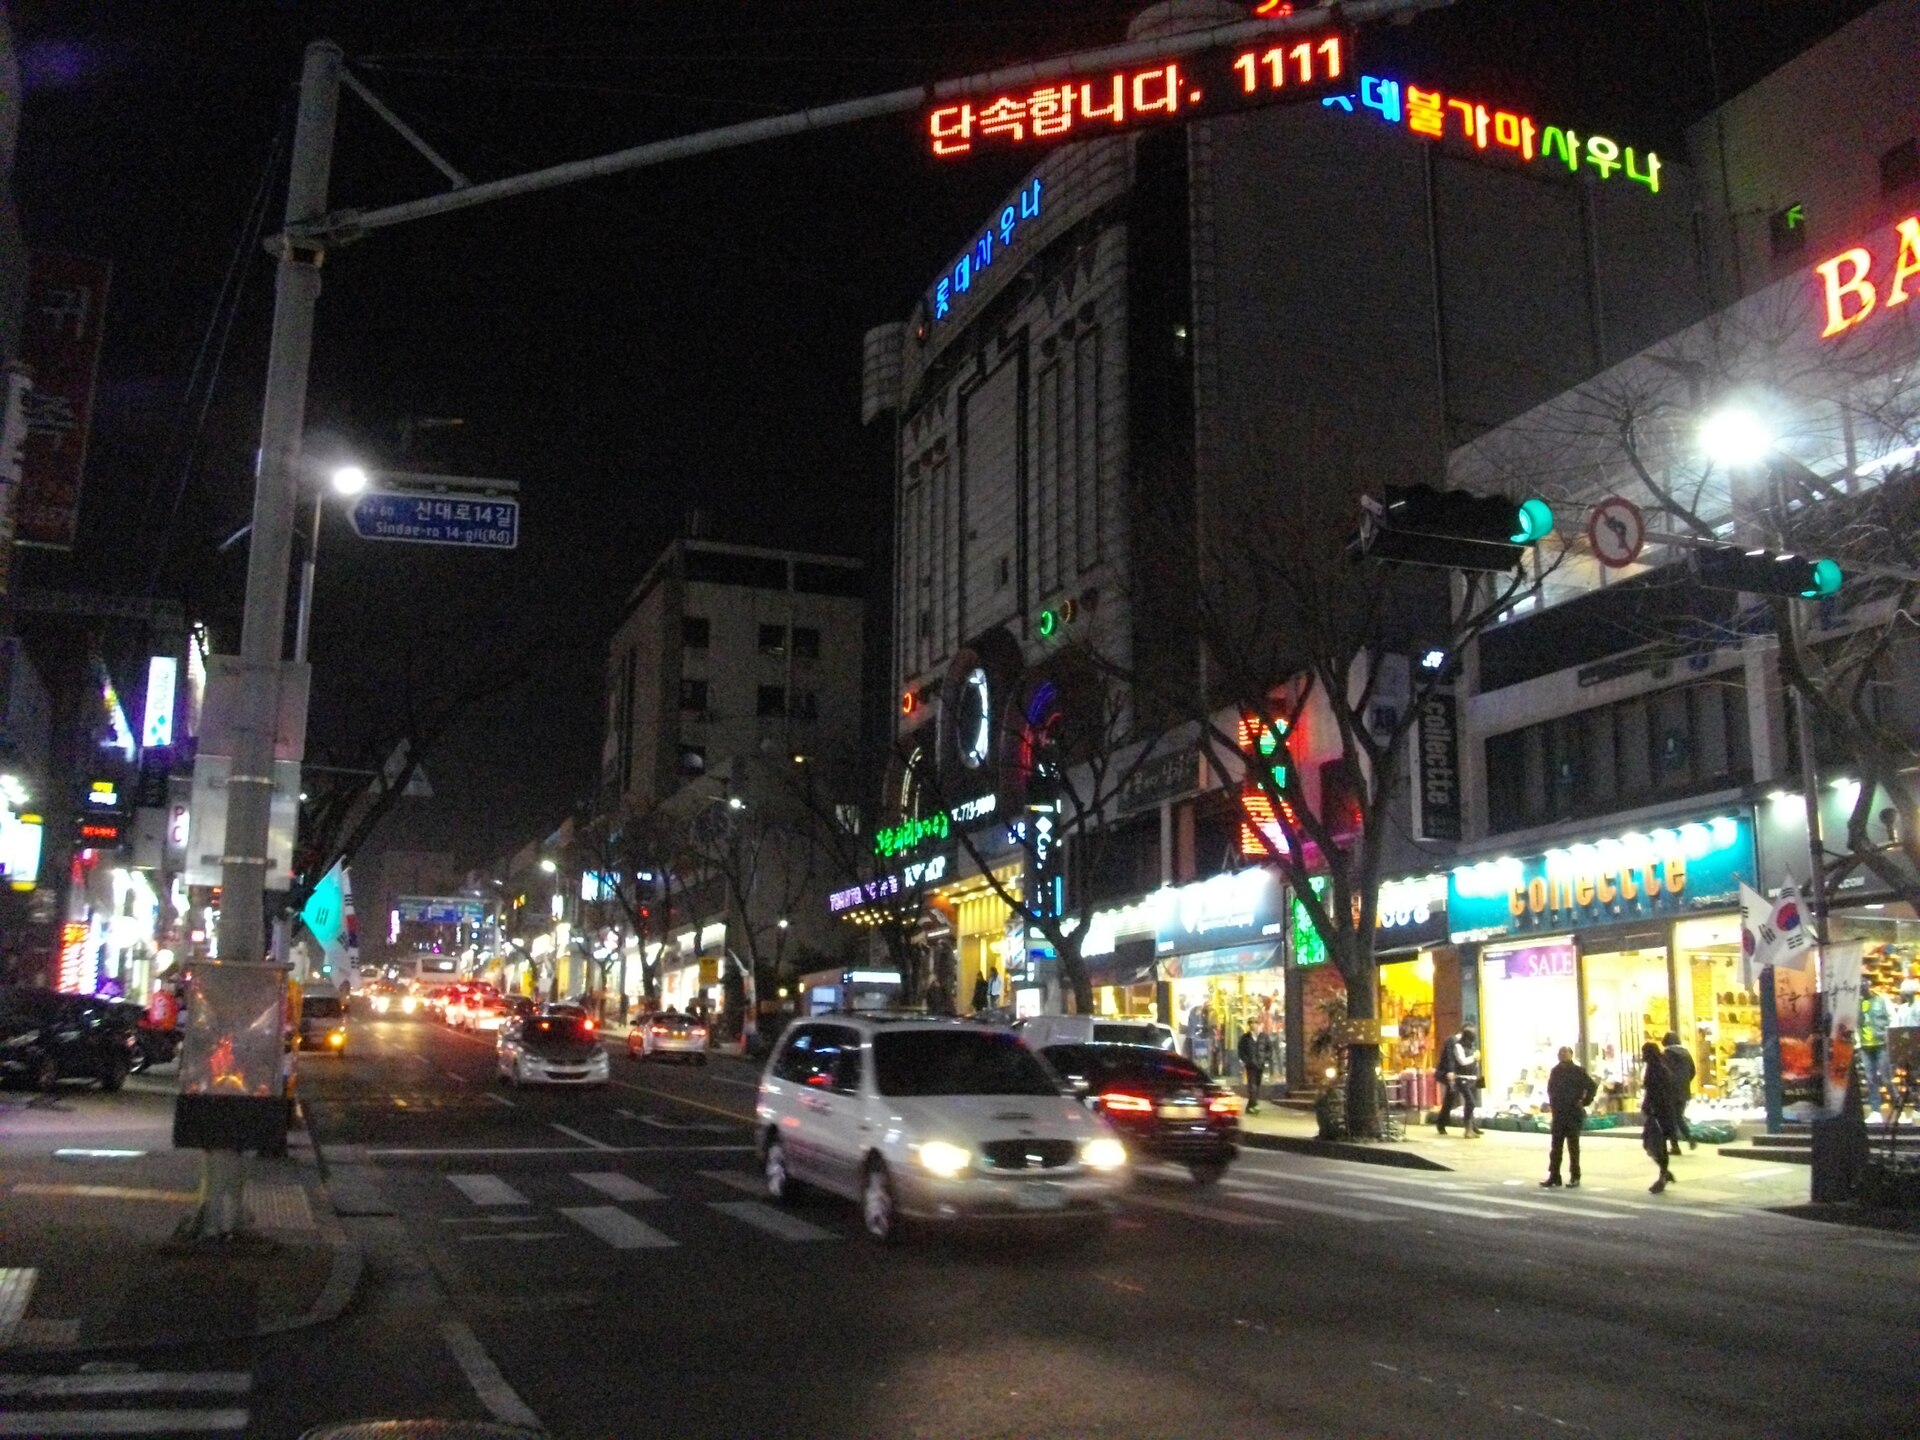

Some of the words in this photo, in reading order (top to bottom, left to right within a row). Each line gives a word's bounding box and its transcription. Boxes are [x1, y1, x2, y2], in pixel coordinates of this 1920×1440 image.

[930, 64, 1203, 156] 단속합니다.
[1233, 36, 1341, 93] 1111
[1528, 952, 1573, 976] SALE
